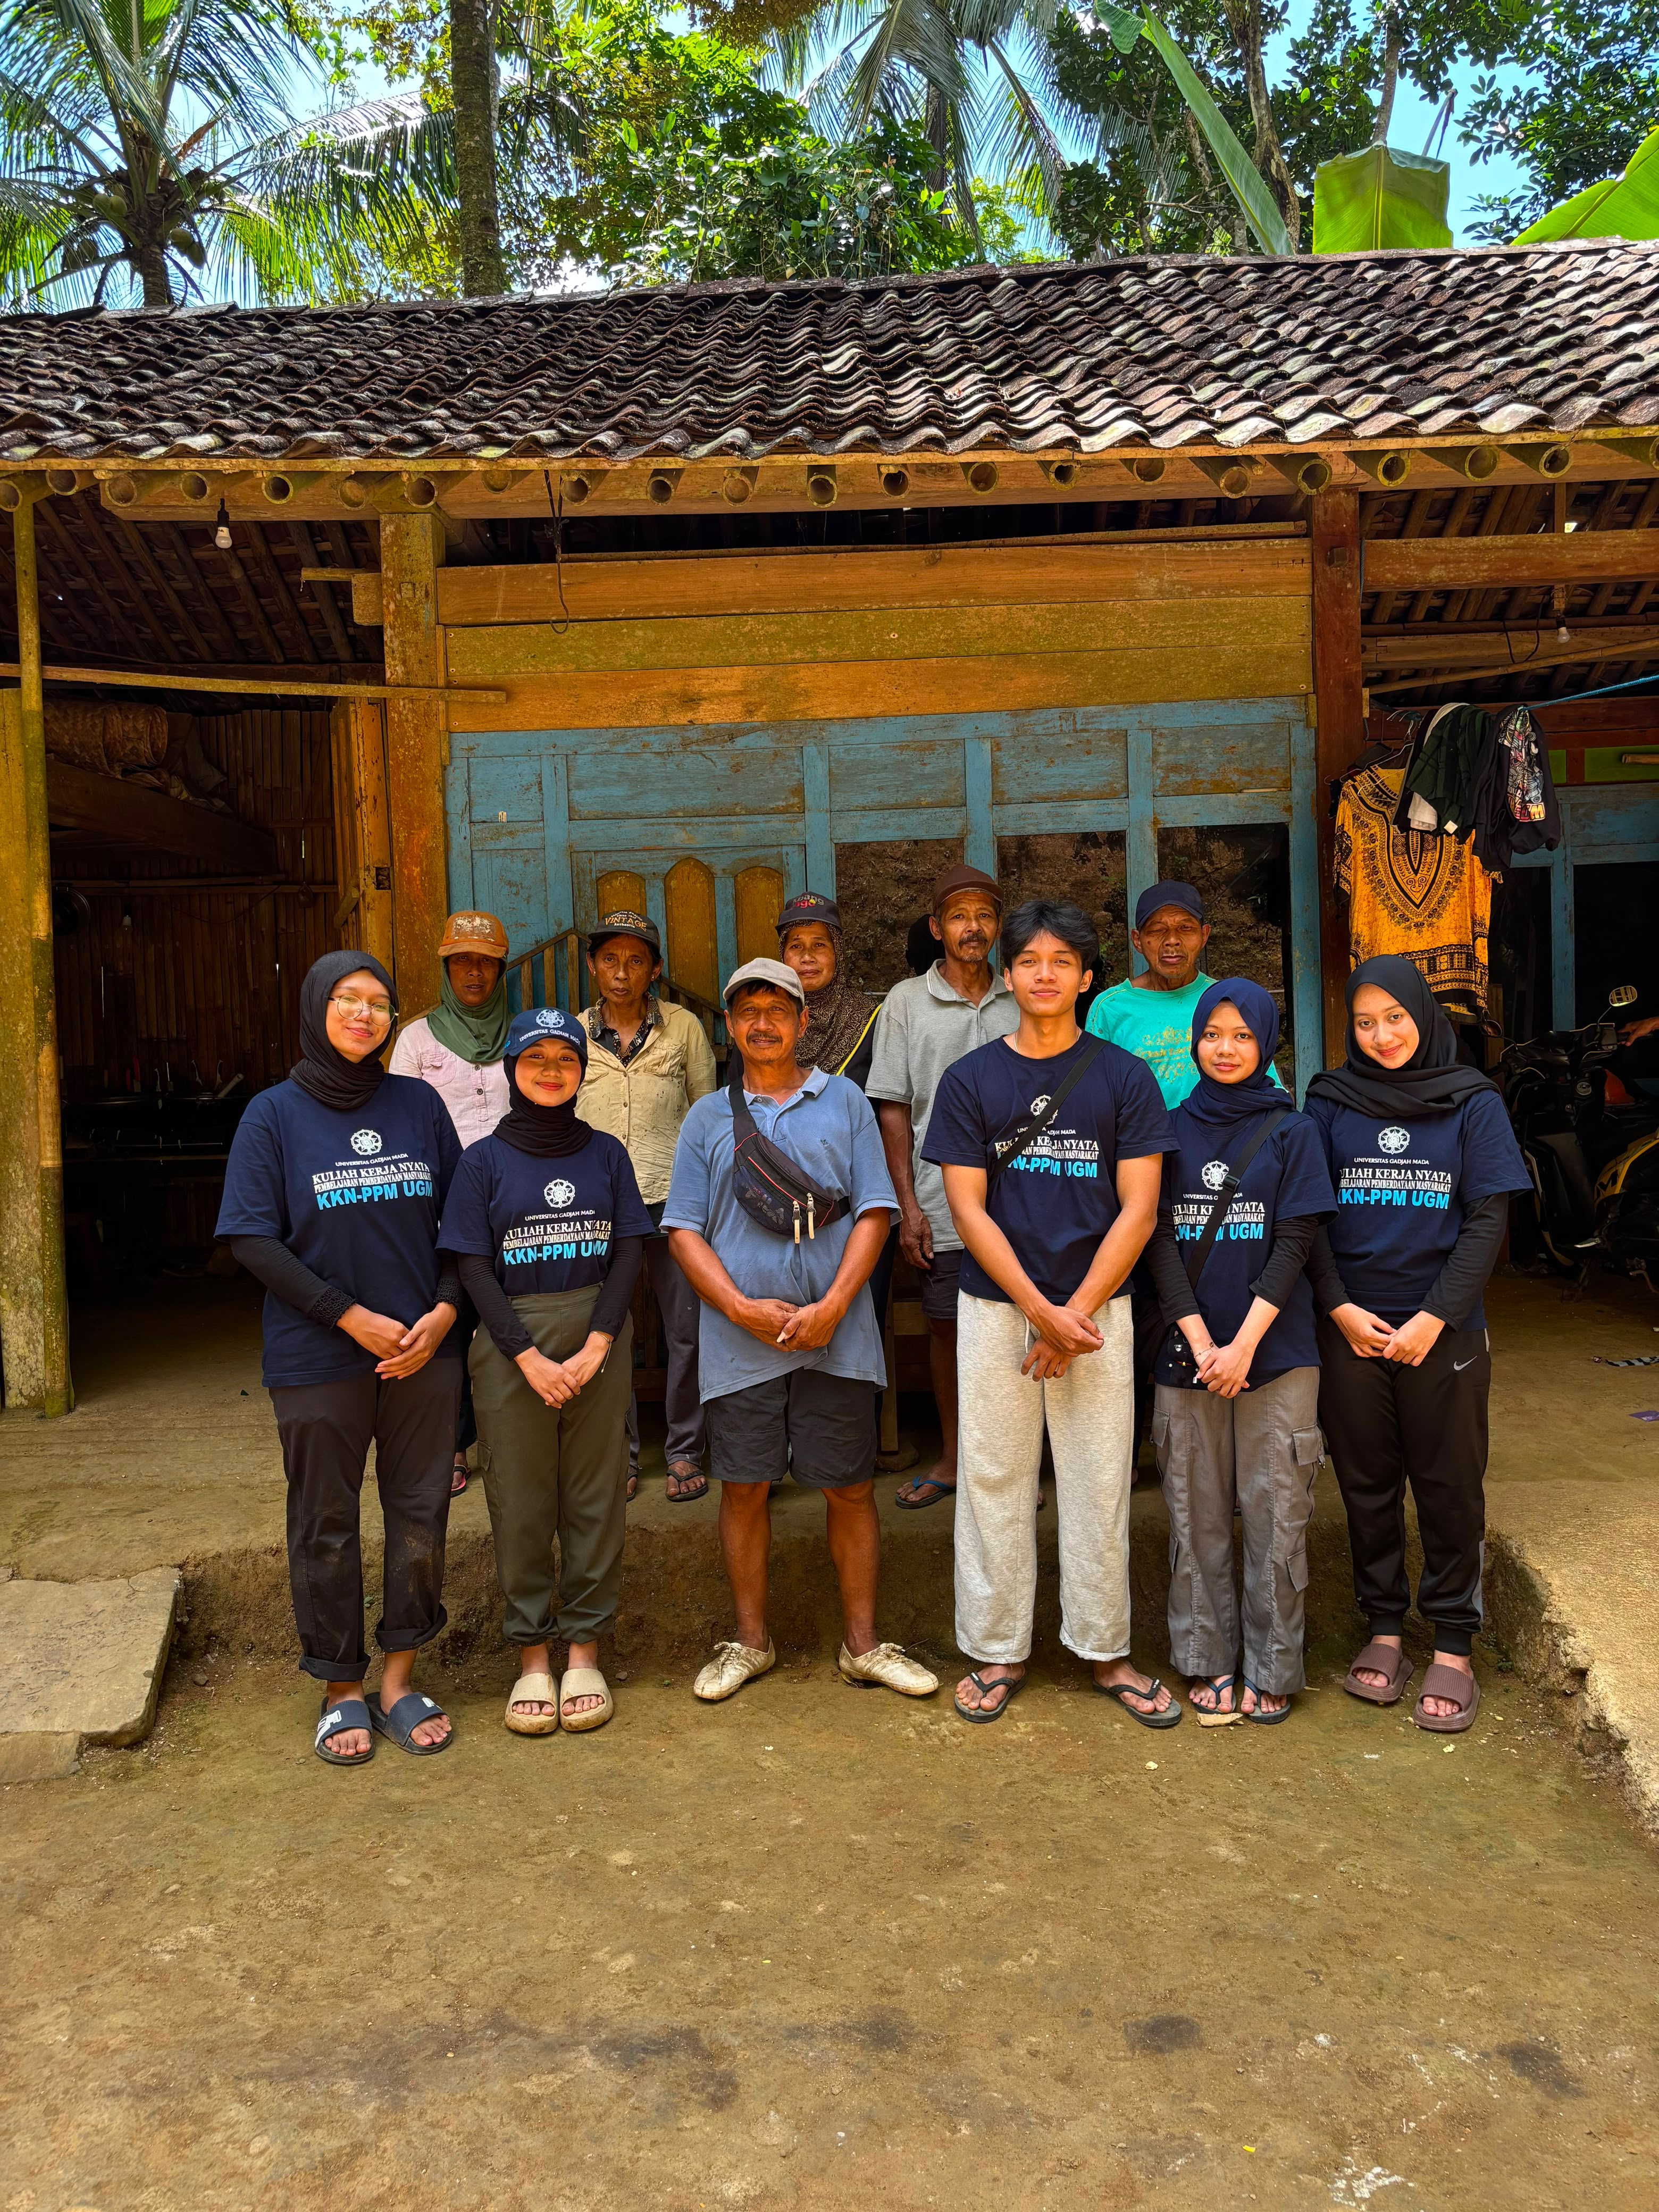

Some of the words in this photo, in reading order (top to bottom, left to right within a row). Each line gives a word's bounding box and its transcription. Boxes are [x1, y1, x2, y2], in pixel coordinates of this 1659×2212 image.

[605, 917, 647, 932] VINTAGE
[1062, 1139, 1100, 1151] NYATA
[370, 1156, 392, 1164] GADJAH
[312, 1169, 358, 1185] KULIAH
[359, 1163, 398, 1178] KERJA
[398, 1161, 430, 1172] NYATA
[1064, 1161, 1097, 1178] UGM
[1375, 1168, 1413, 1180] KERJA
[1414, 1170, 1452, 1183] NYATA
[314, 1178, 358, 1194] PEMBELAJARAN
[358, 1172, 403, 1186] PEMBERDAYAAN
[1371, 1179, 1416, 1189] PEMBERDAYAAN
[1415, 1180, 1451, 1193] MASYARAKAT
[316, 1183, 398, 1210] KKN-PPM
[403, 1180, 433, 1197] UGM
[1412, 1190, 1449, 1210] UGM
[1231, 1202, 1266, 1213] NYATA
[546, 1221, 582, 1235] KERJA
[1229, 1223, 1264, 1240] UGM
[543, 1231, 584, 1244] PEMBERDAYAAN
[503, 1242, 576, 1266] KKN-PPM
